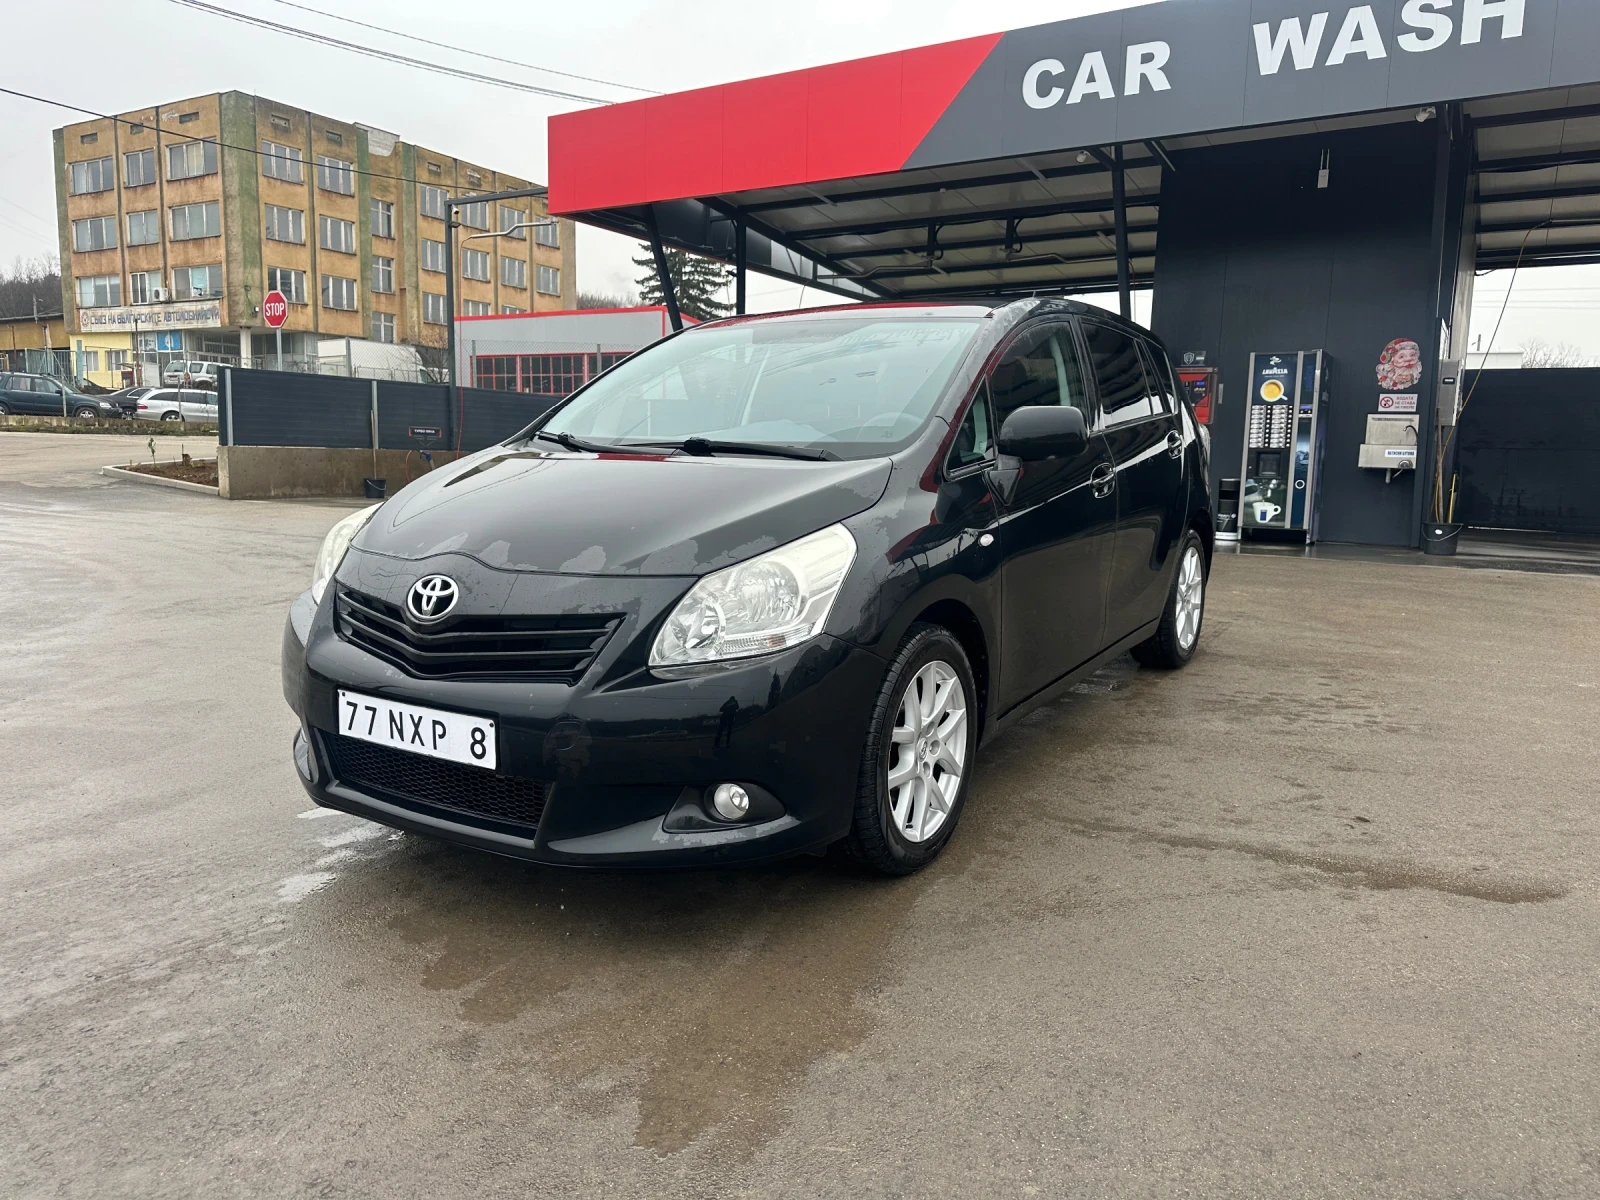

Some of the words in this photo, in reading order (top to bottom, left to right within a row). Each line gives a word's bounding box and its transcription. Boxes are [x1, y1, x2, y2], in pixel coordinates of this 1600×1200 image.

[1023, 41, 1171, 109] CAR
[1253, 0, 1525, 75] WASH
[107, 312, 117, 325] НА
[117, 311, 161, 325] БЪЛГАРСКИТЕ
[265, 302, 285, 317] STOP
[346, 701, 377, 735] 77
[389, 709, 447, 750] NXP
[470, 727, 487, 760] 8
